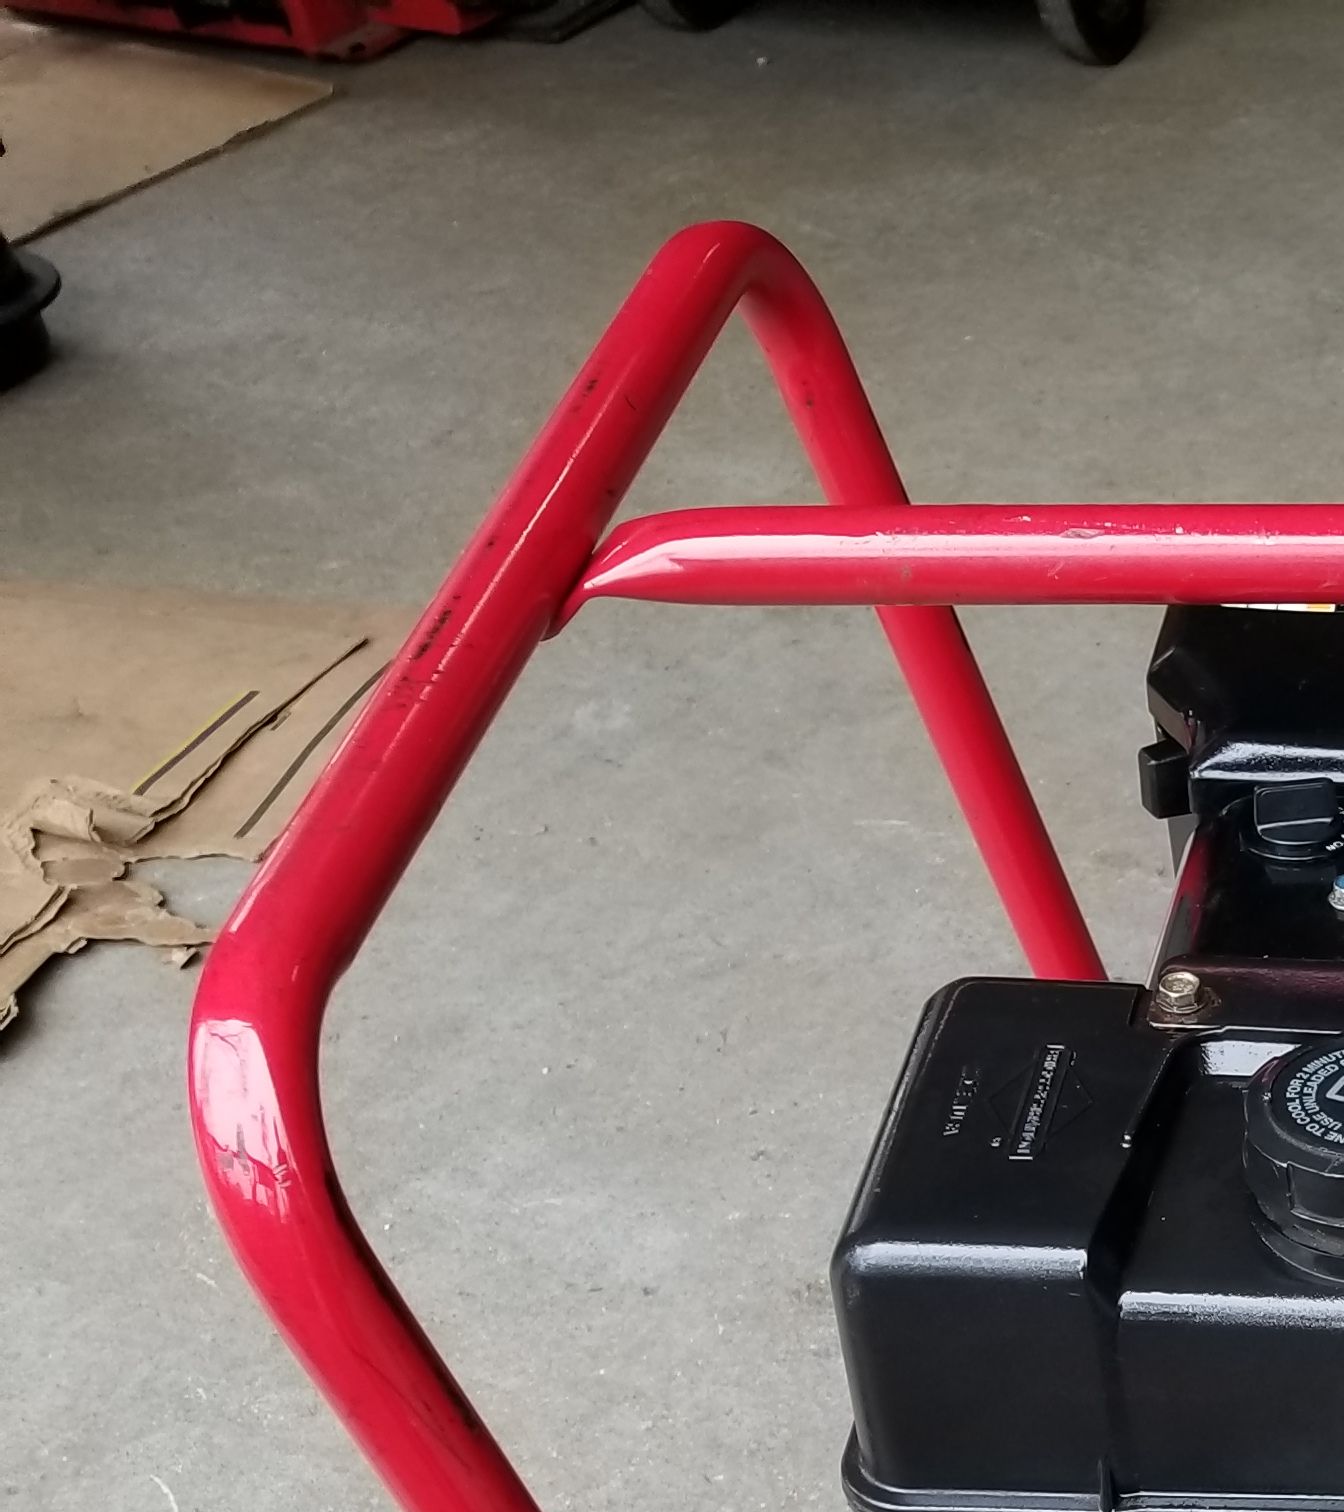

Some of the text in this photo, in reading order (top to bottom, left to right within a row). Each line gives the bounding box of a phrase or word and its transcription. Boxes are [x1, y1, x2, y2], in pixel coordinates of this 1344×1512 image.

[1299, 1071, 1310, 1080] 2
[1286, 1077, 1304, 1098] FOR
[1303, 1064, 1339, 1115] UNLEADED
[1286, 1098, 1311, 1125] COOL
[1312, 1110, 1343, 1131] USE
[1306, 1123, 1327, 1137] TO
